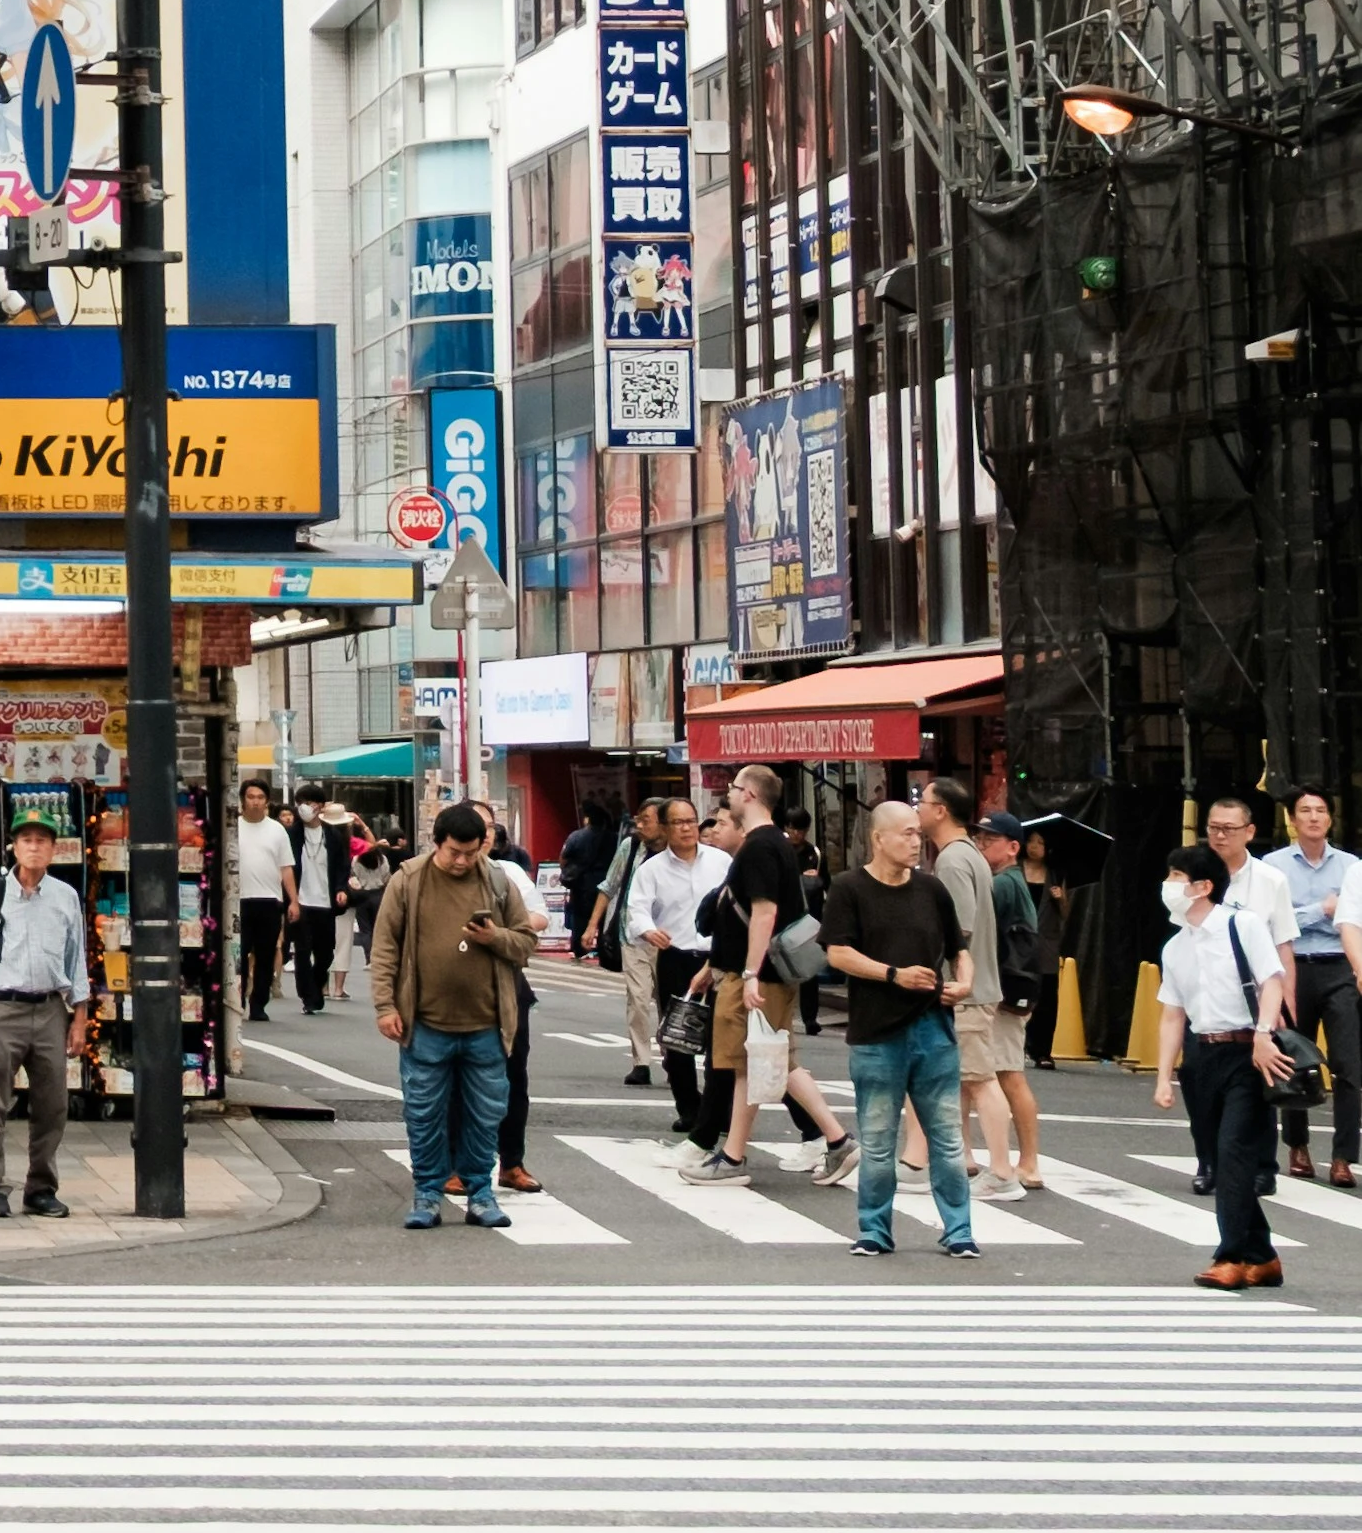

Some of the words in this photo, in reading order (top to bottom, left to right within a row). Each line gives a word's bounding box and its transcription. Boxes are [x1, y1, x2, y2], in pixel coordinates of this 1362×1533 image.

[607, 40, 679, 75] カード
[606, 81, 683, 116] ゲーム
[610, 145, 682, 181] 販売
[611, 187, 683, 222] 買取
[33, 226, 63, 261] 8-20
[426, 239, 480, 262] Models
[13, 435, 227, 478] KiYohi
[51, 494, 89, 511] LED
[93, 493, 297, 512] 照明用しております。
[401, 509, 442, 530] 消火栓
[60, 565, 121, 584] 支付宝
[60, 584, 120, 593] ALIPAY
[179, 567, 237, 583] 微信支付
[719, 724, 749, 755] TOKYO
[748, 722, 777, 754] RADIO
[777, 719, 841, 753] DEPARTMENT
[841, 718, 875, 752] STORE
